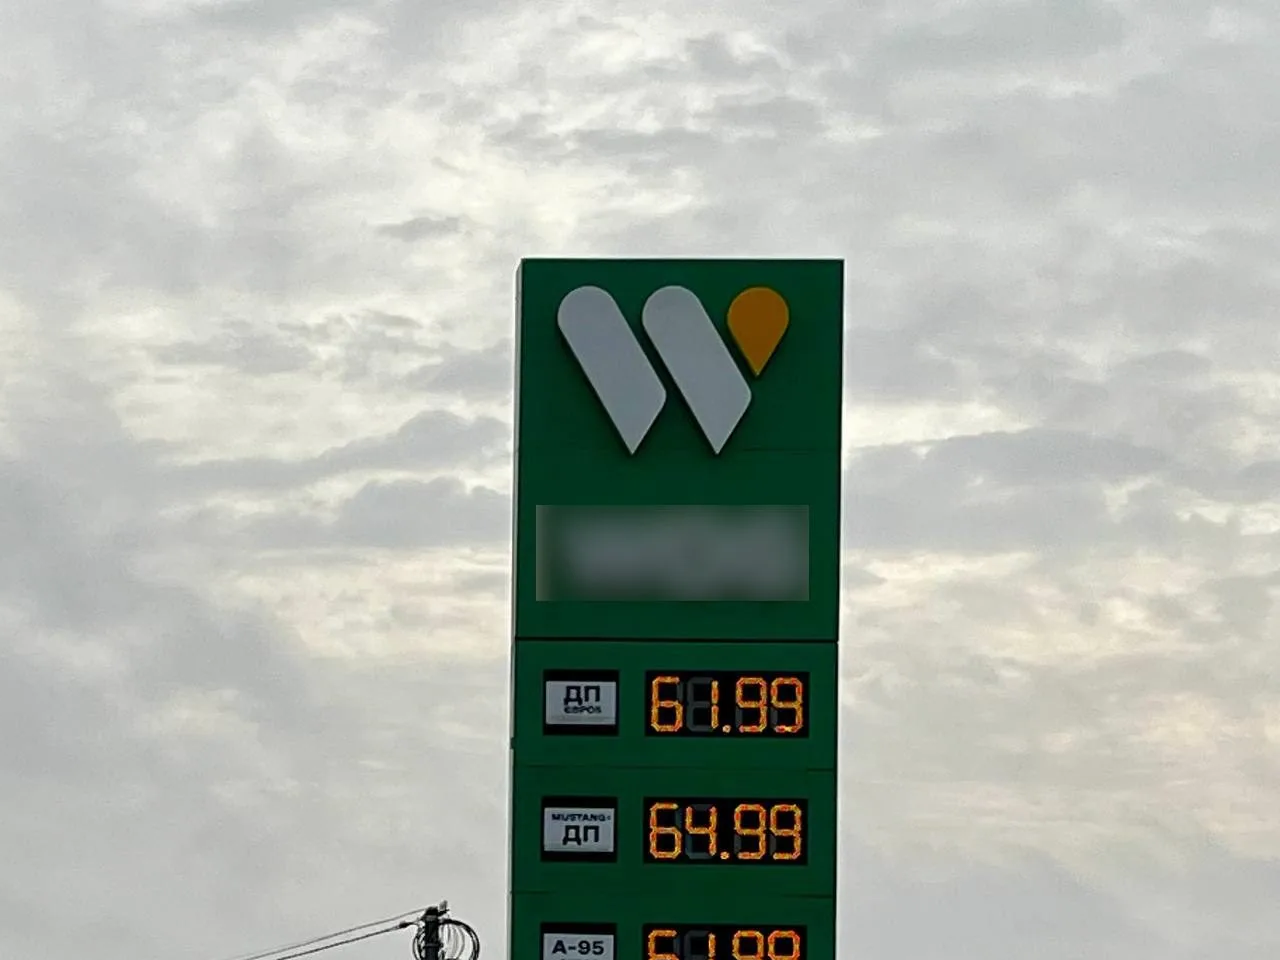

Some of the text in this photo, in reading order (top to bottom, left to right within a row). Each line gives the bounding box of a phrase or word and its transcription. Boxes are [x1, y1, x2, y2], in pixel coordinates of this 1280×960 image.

[564, 685, 601, 706] ДП
[650, 676, 804, 733] 61.99
[563, 825, 600, 846] ДП
[648, 802, 802, 860] 64.99
[552, 939, 605, 956] А-95
